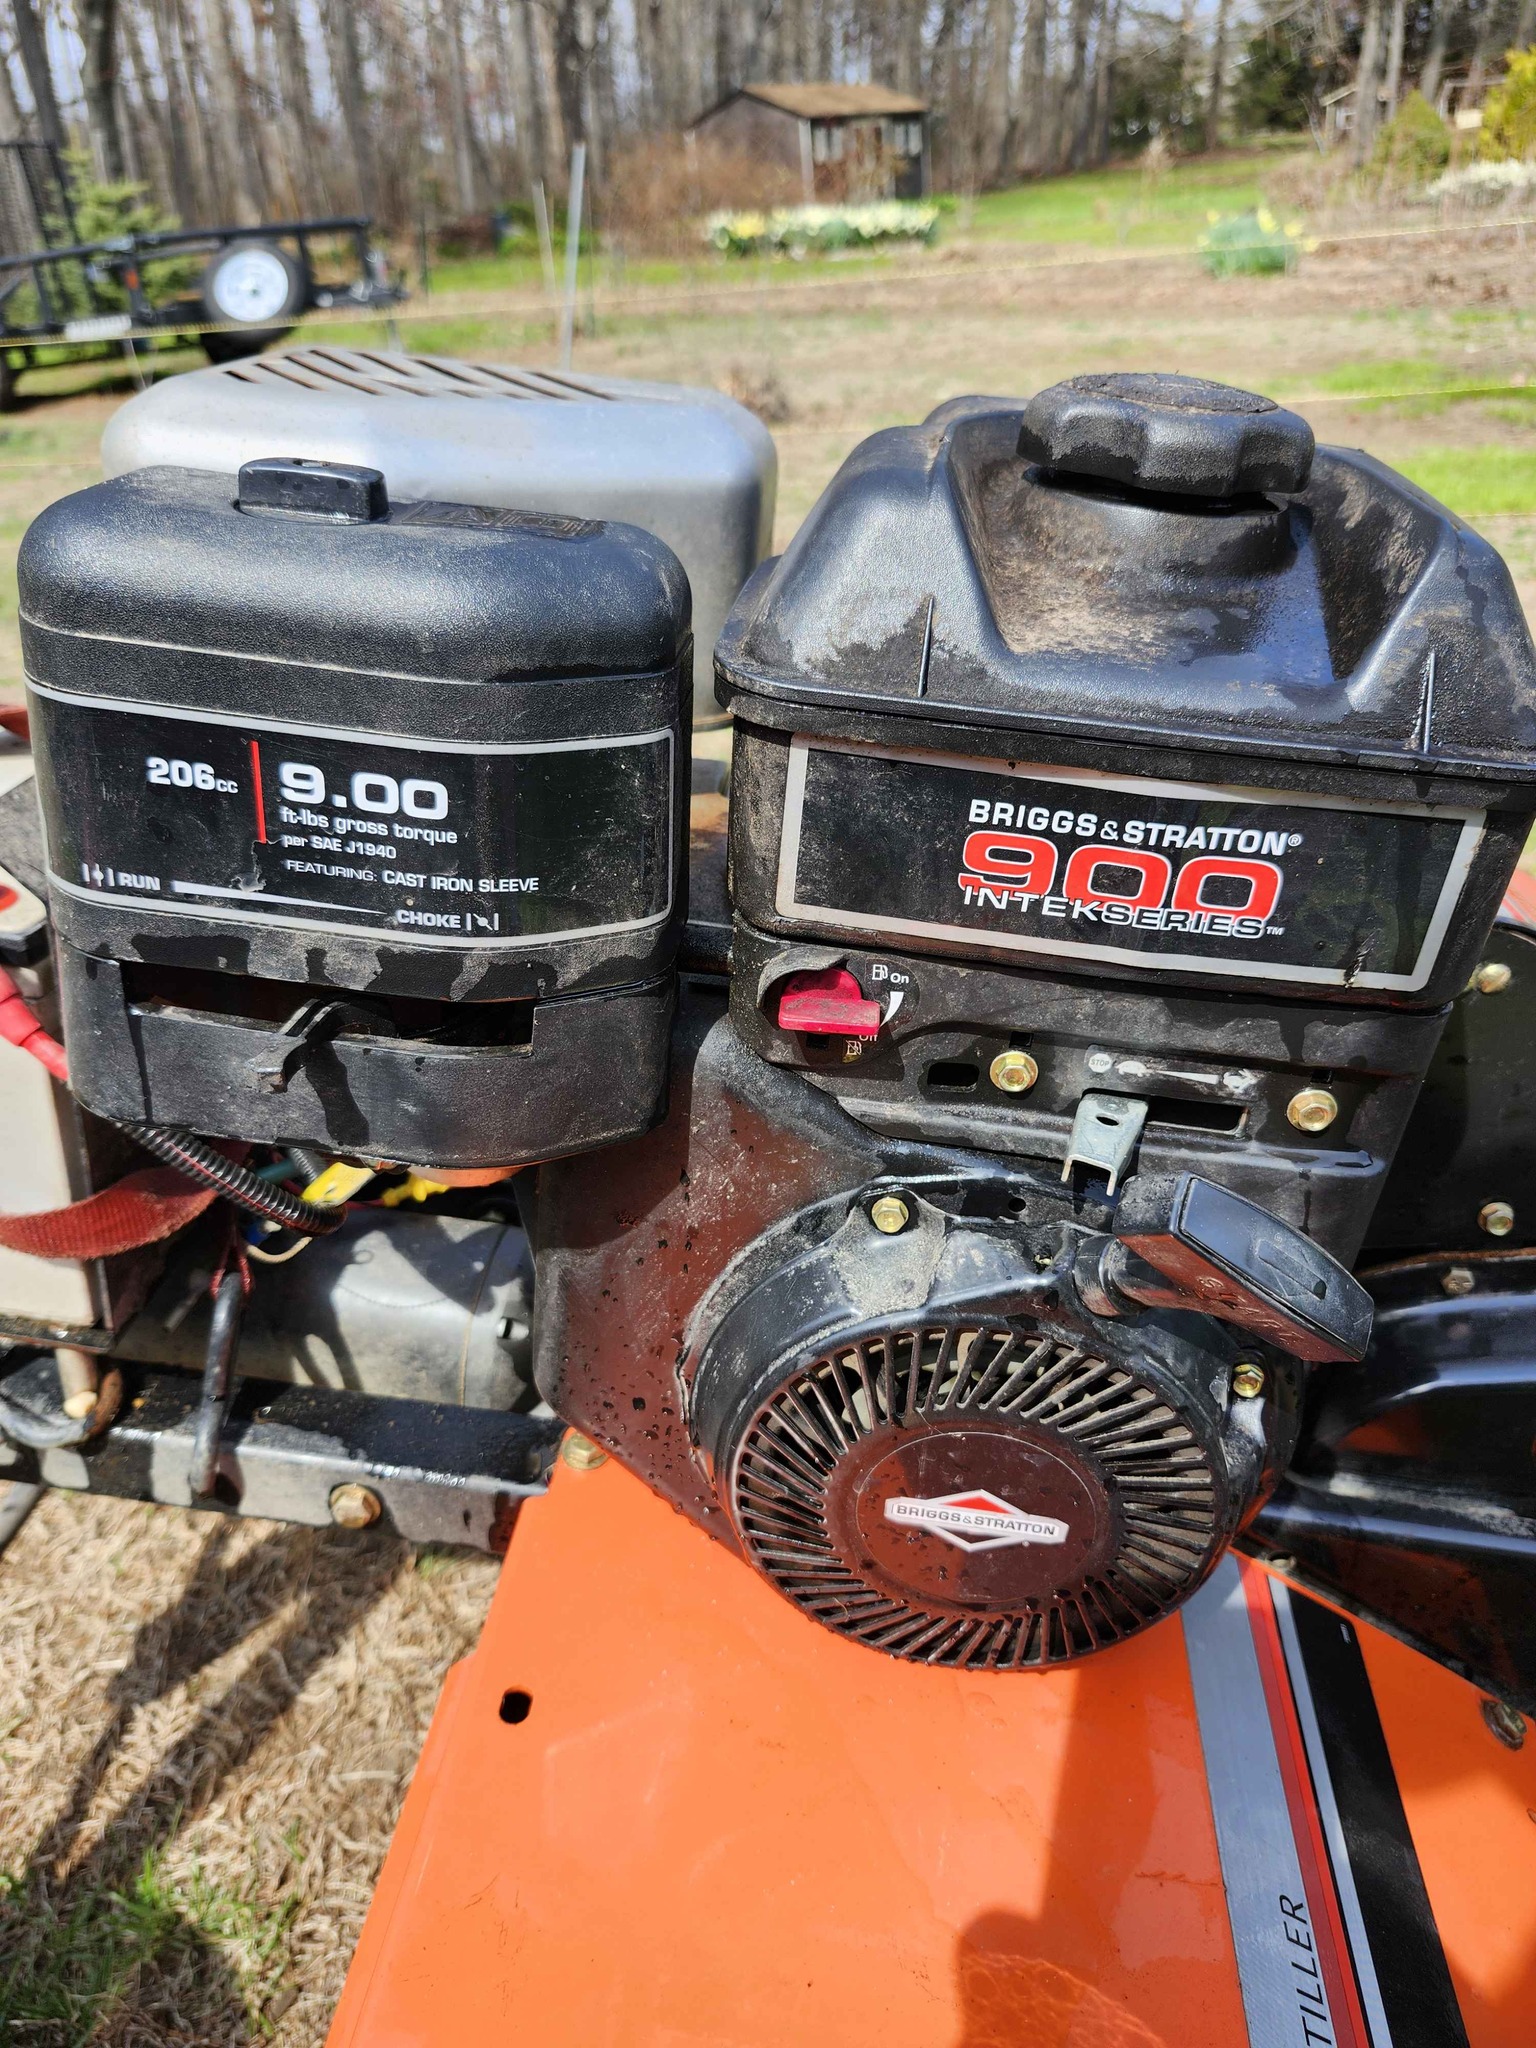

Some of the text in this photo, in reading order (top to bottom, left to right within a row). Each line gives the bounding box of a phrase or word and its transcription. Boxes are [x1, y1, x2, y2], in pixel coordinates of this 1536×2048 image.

[146, 756, 239, 794] 206cc
[279, 762, 449, 820] 9.00
[280, 806, 458, 846] ft-lbs gross torque
[282, 834, 397, 859] per SAE J1940
[115, 871, 161, 891] RUN
[286, 859, 540, 893] FEATURING: CAST IRON SLEEVE
[958, 830, 1284, 922] 900
[396, 909, 461, 930] CHOKE
[890, 972, 910, 984] On
[1089, 1057, 1110, 1068] STOP
[1279, 1894, 1332, 2047] TILLER
